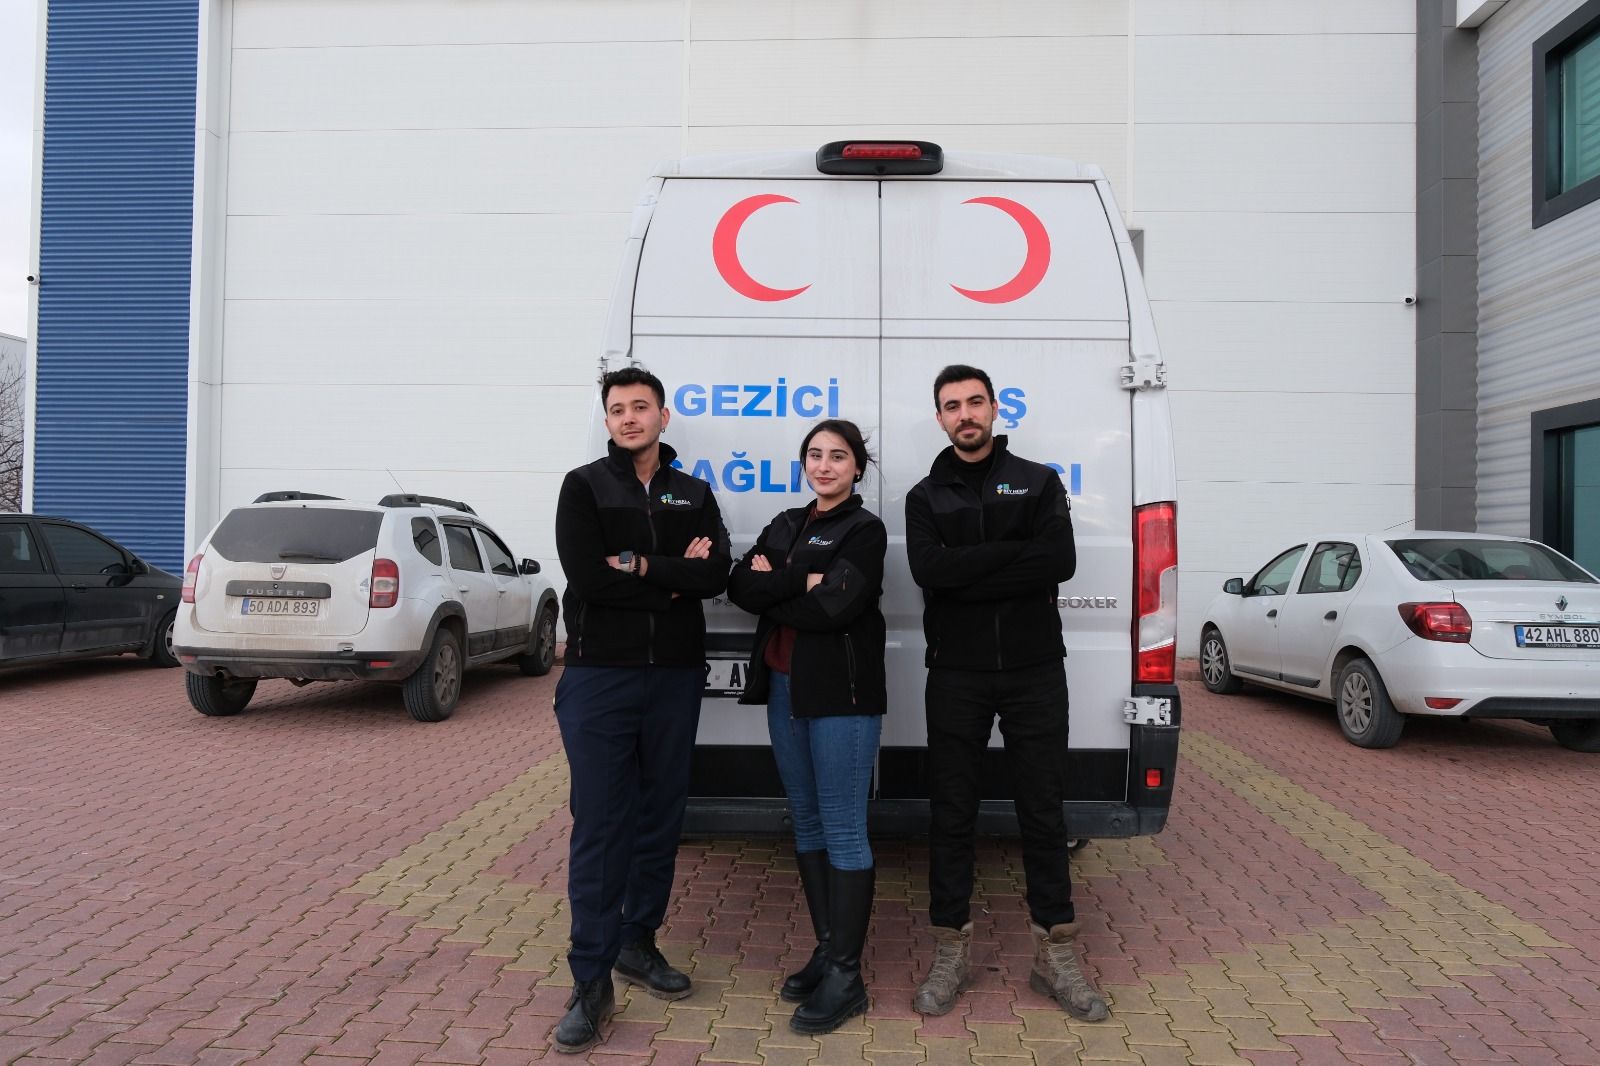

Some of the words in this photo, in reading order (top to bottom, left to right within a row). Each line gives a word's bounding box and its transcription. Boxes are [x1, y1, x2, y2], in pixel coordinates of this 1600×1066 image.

[673, 377, 839, 418] GEZİCİ
[998, 387, 1027, 429] Ş
[671, 451, 812, 493] AĞLI
[246, 588, 305, 596] DUSTER
[249, 600, 264, 613] 50
[266, 601, 289, 613] ADA
[293, 601, 317, 614] 893
[1057, 596, 1118, 609] BOXER
[1525, 627, 1543, 642] 42
[1546, 628, 1572, 643] AHL
[1573, 628, 1599, 643] 880
